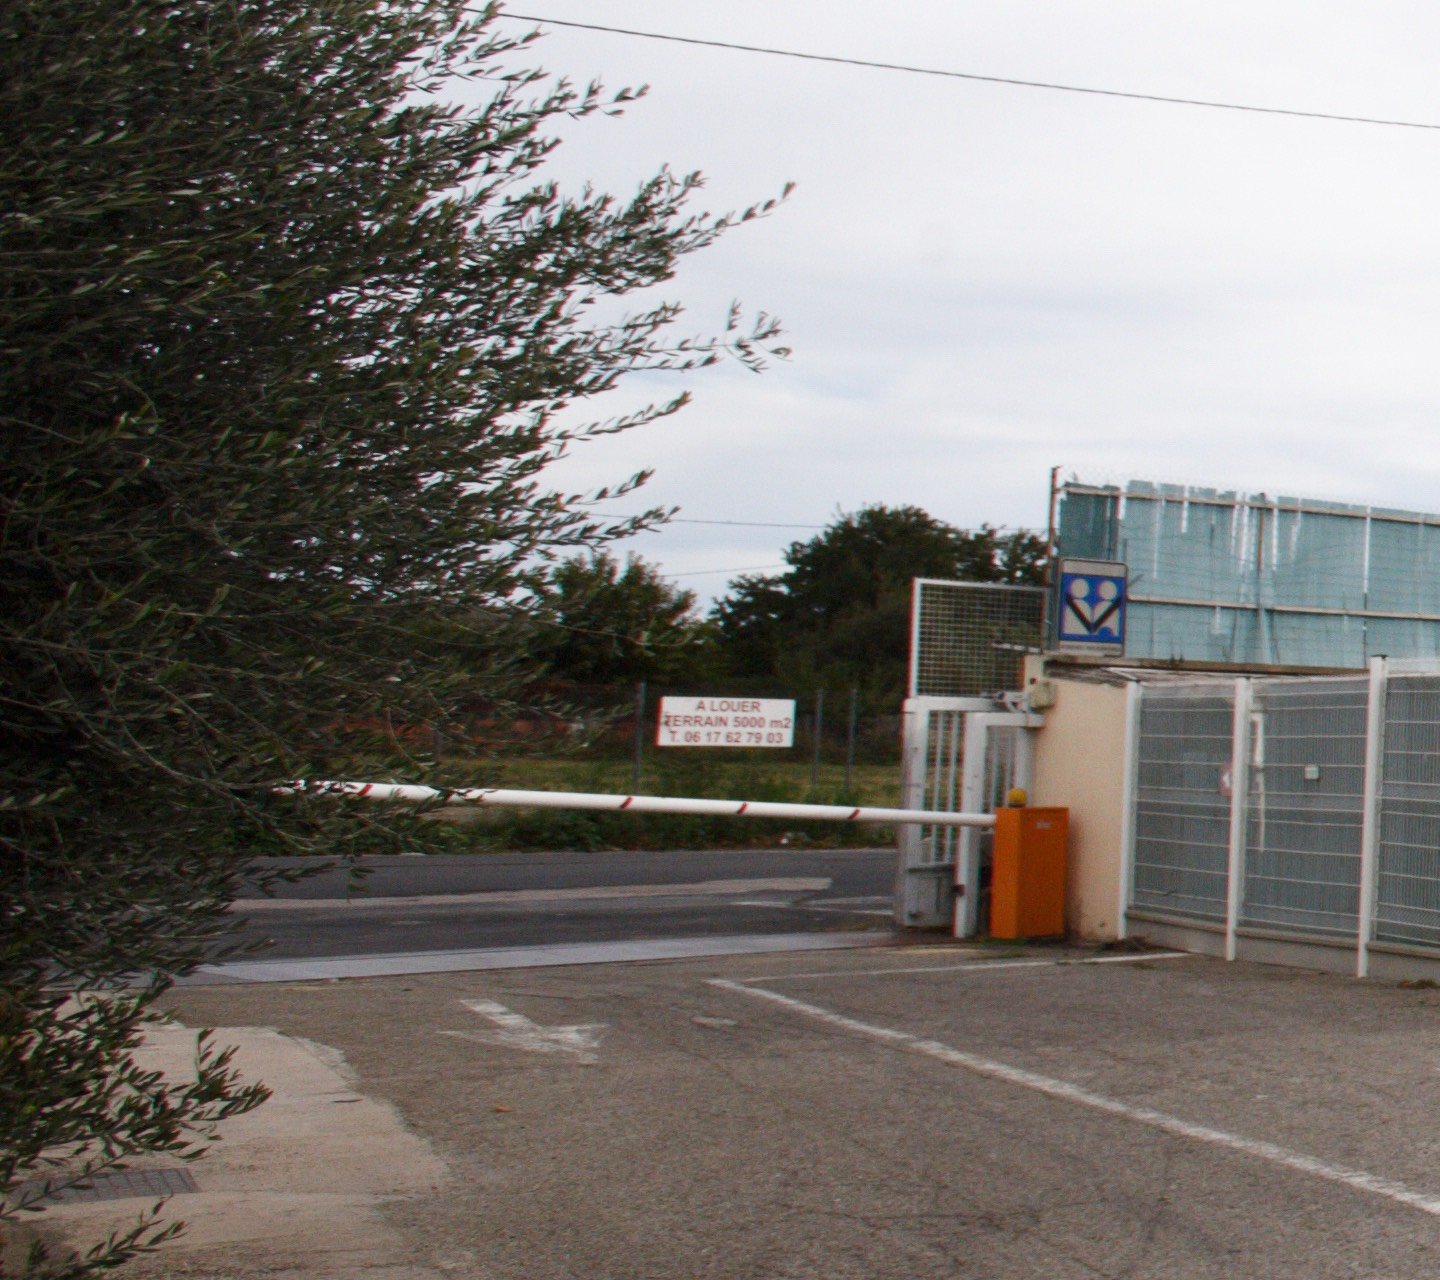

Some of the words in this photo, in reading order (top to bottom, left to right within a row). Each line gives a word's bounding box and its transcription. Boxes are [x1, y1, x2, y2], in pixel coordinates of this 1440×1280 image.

[696, 700, 706, 711] A
[711, 700, 761, 713] LOUER
[664, 713, 729, 728] TERRAIN
[734, 716, 766, 729] 5000
[684, 730, 701, 742] 06
[706, 731, 721, 743] 17
[746, 732, 763, 743] 79
[767, 732, 784, 744] 03
